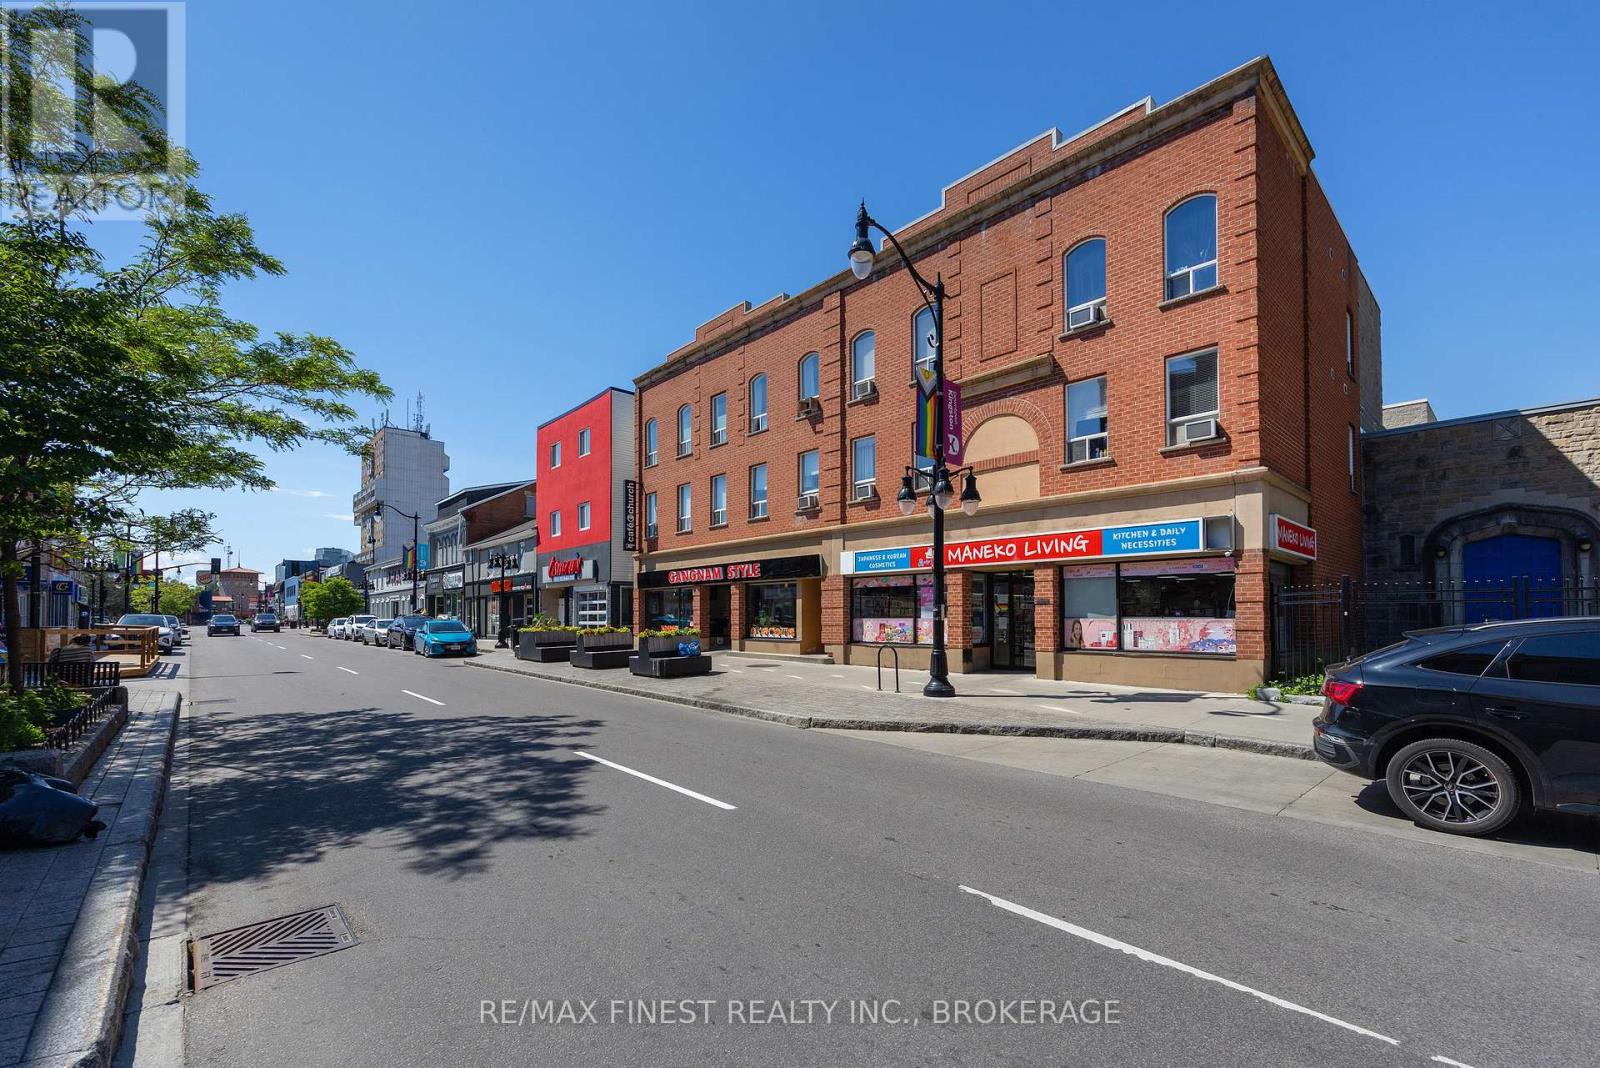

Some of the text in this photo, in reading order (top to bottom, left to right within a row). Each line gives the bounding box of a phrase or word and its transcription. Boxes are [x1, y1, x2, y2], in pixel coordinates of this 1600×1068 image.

[1112, 527, 1186, 540] KITCHEN & DAILY
[1279, 525, 1298, 546] MANEKO
[947, 535, 1089, 562] MANEKO LIVING
[1121, 538, 1177, 550] NECESSITIES
[858, 554, 881, 562] JAPANESE
[887, 552, 907, 560] KOREAN
[869, 561, 896, 569] COSMETICS
[668, 563, 761, 584] GANGNAM STYLE
